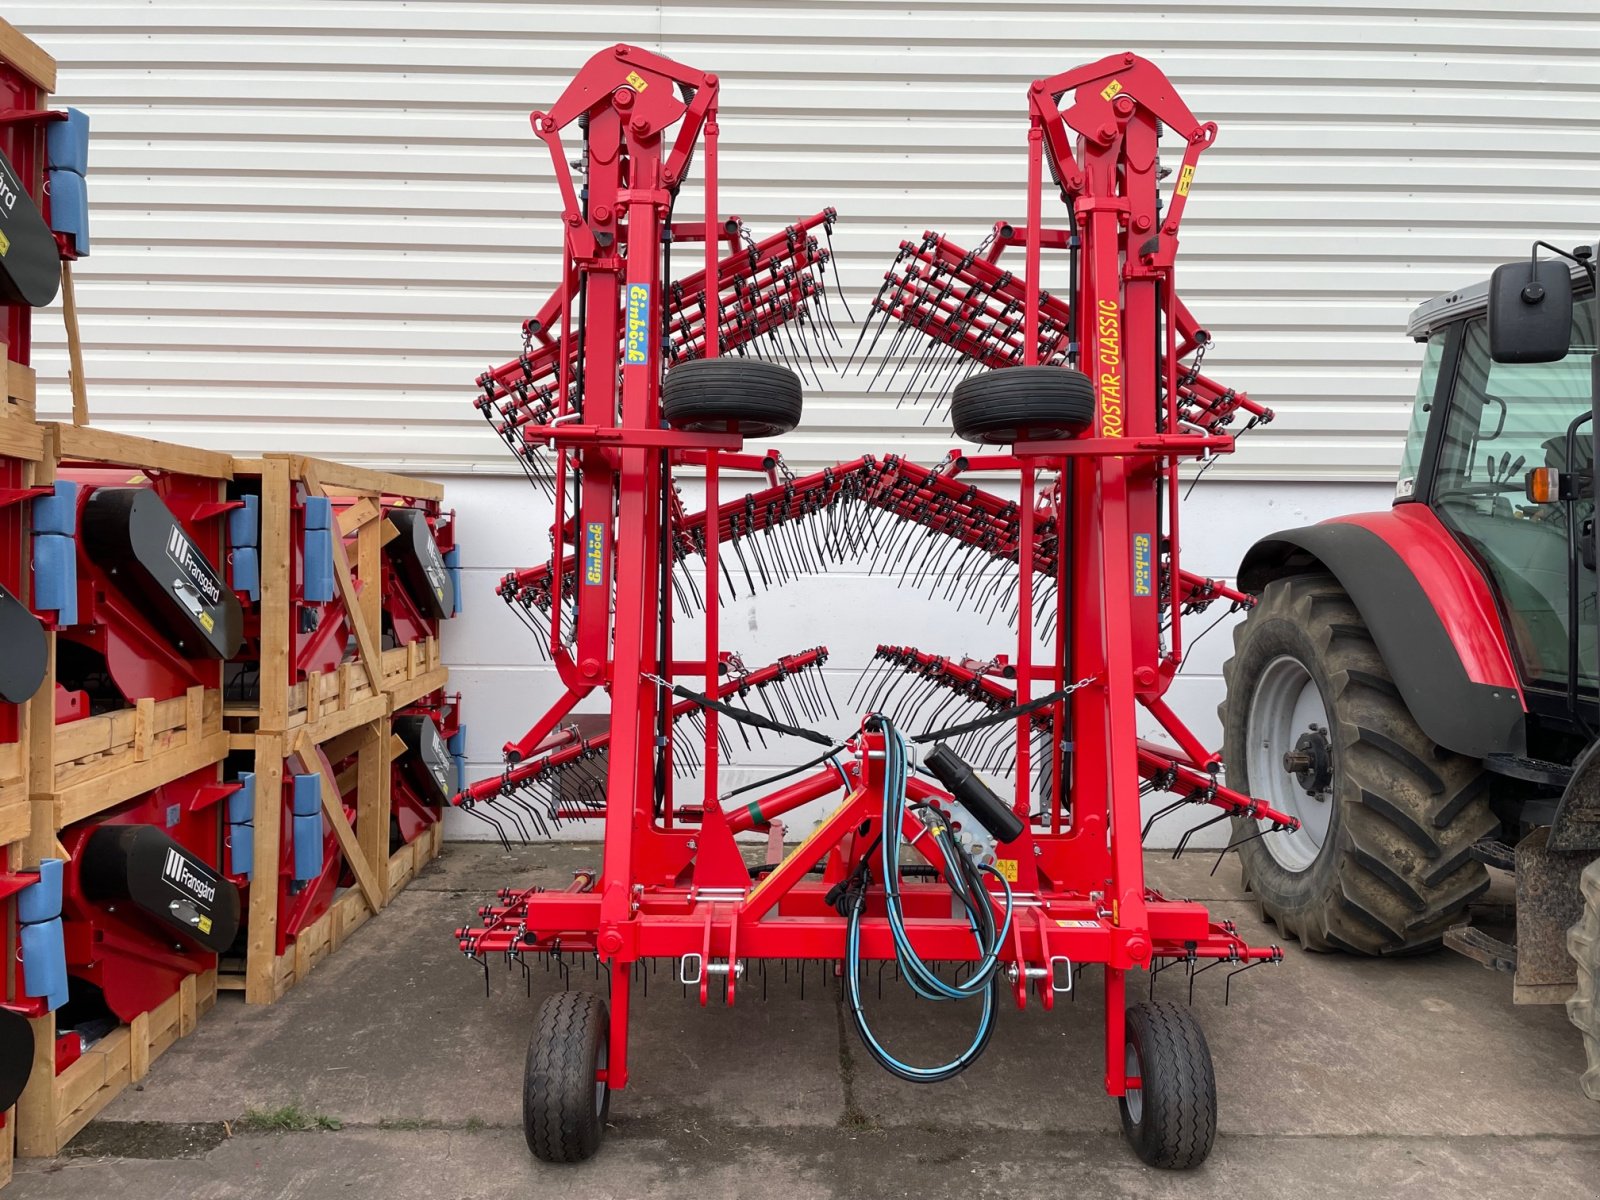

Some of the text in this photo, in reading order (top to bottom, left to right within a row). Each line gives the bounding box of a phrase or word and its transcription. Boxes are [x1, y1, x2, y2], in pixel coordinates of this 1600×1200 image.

[628, 286, 647, 361] Einböck
[1099, 300, 1123, 459] ROSTAR-CLASSIC
[185, 552, 220, 603] Fransgård
[588, 524, 602, 583] Einböck
[1135, 535, 1149, 594] Einböck
[181, 867, 215, 902] Fransgård
